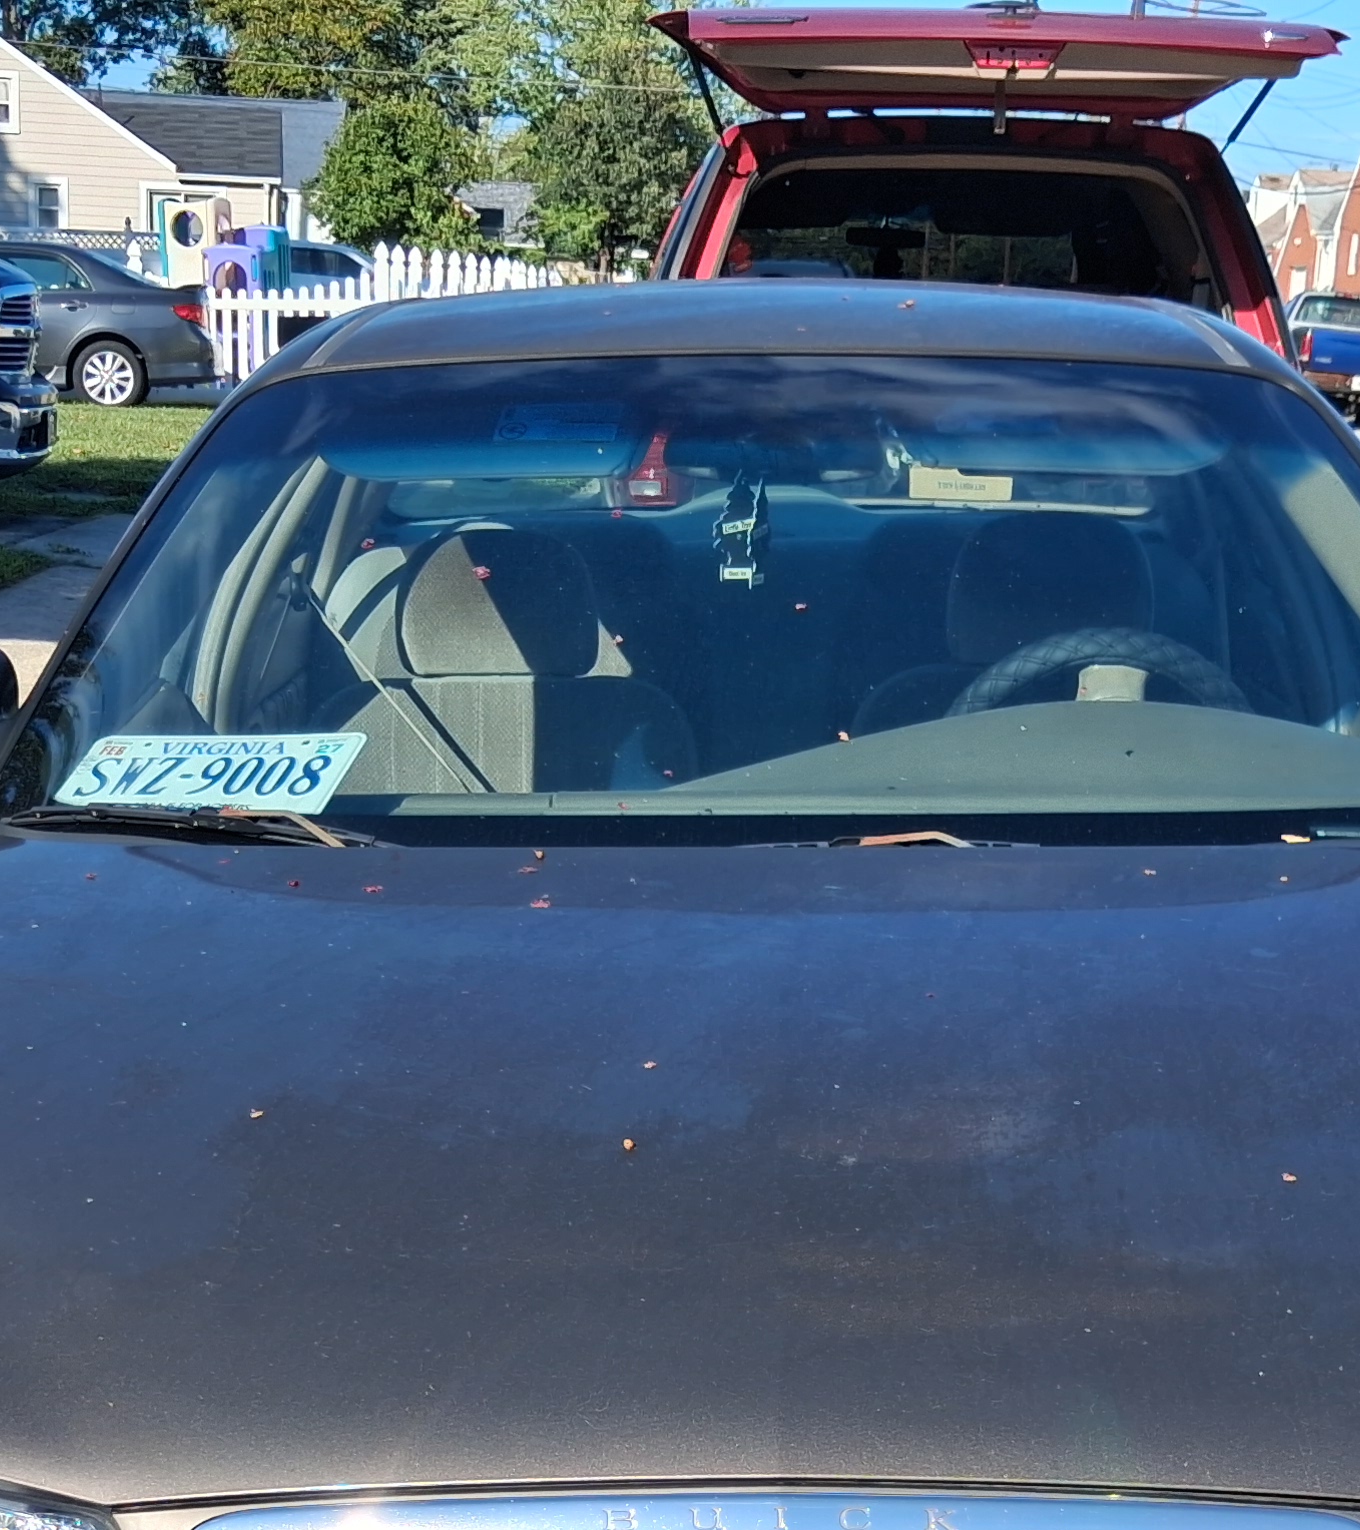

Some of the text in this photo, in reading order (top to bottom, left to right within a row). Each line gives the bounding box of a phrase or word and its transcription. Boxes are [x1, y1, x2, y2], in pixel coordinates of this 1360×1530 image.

[99, 745, 127, 755] FEB
[163, 741, 285, 755] VIRGINIA
[315, 743, 344, 754] 27
[72, 755, 332, 796] SWZ-9008
